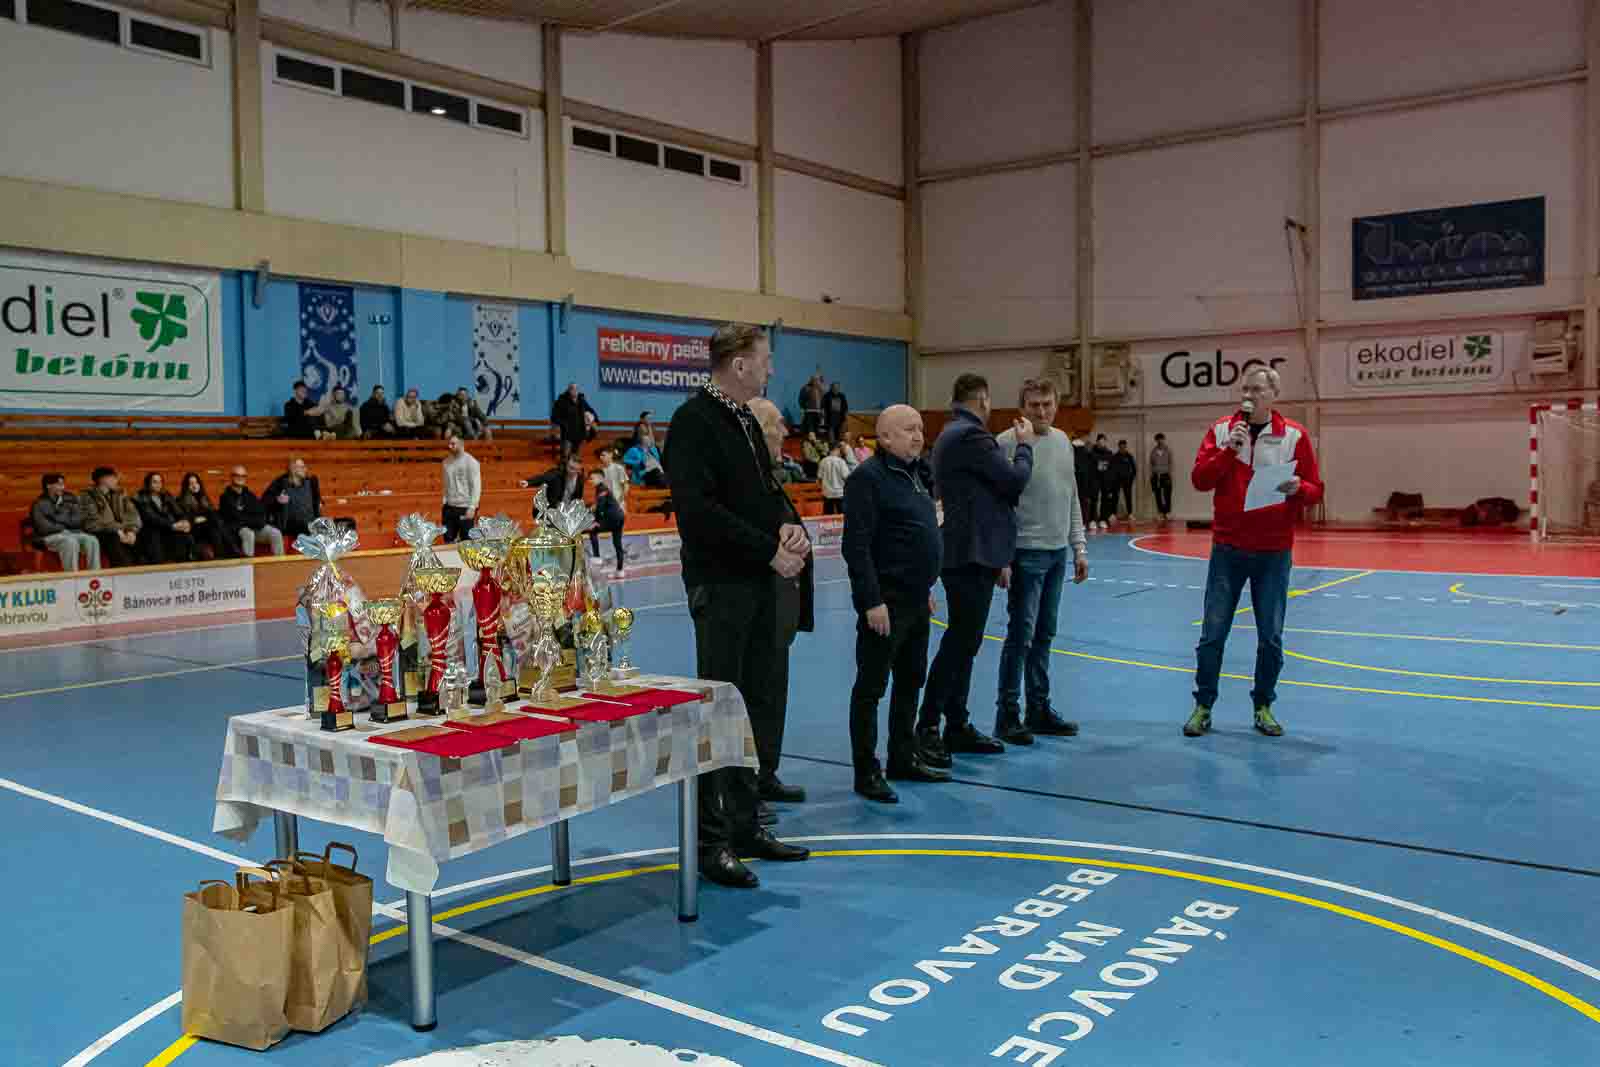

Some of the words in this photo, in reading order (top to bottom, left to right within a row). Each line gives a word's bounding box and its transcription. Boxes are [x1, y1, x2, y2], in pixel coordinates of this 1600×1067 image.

[600, 334, 670, 361] reklamy
[1357, 338, 1454, 364] ekodiel
[16, 347, 191, 381] betónu
[601, 367, 711, 387] www.cosmos
[1161, 350, 1286, 388] Gab
[12, 588, 57, 608] KLUB
[123, 594, 171, 609] Bánovce
[175, 591, 195, 604] nad
[199, 587, 247, 602] Bebravou
[822, 868, 1119, 1037] BEBRAVOU
[998, 920, 1125, 990] NAD
[989, 900, 1239, 1067] BÁNOVCE
